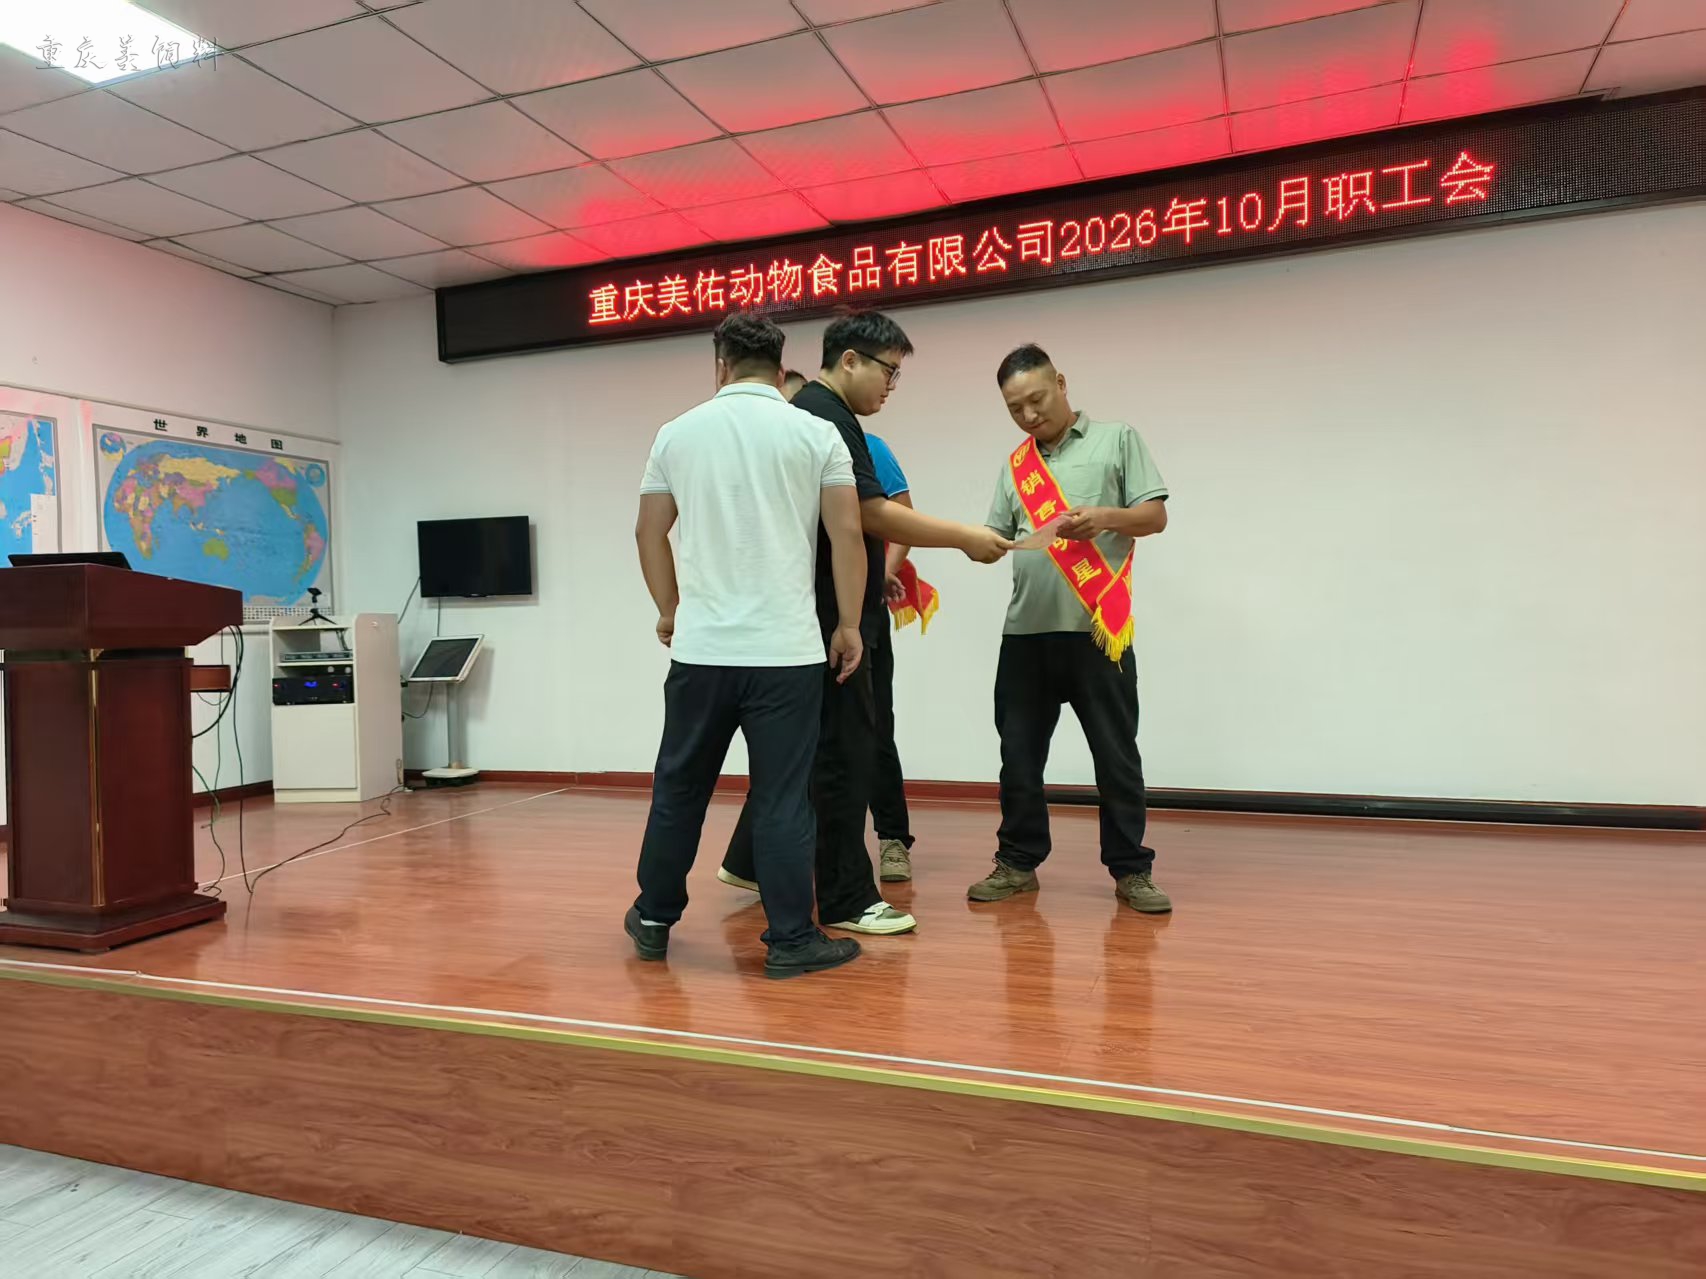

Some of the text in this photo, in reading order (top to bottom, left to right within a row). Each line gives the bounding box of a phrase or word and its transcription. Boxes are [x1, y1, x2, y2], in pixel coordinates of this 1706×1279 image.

[588, 151, 1494, 325] 重庆美佑动物食品有限公司2026年10月职工会
[153, 418, 283, 450] 世界地图
